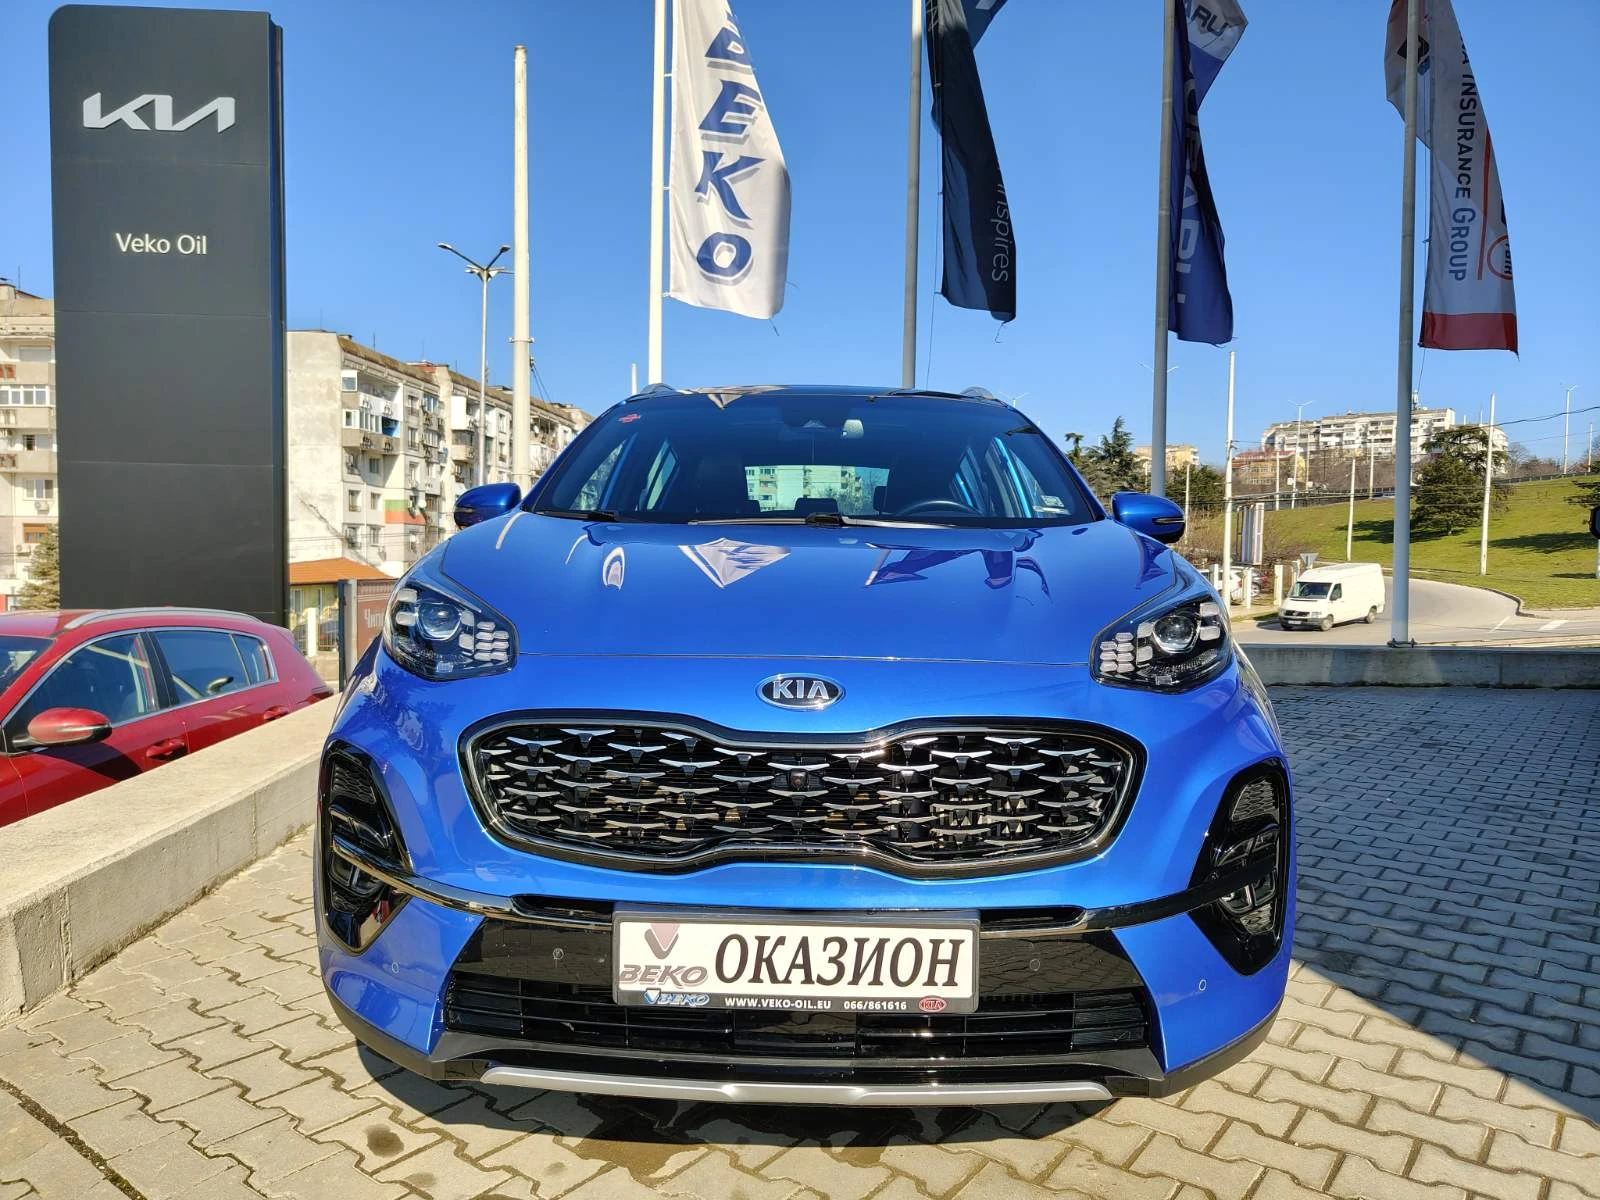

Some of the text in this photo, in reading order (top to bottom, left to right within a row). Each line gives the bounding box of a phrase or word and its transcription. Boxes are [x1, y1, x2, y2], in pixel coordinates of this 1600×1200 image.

[83, 92, 235, 133] KIA
[1454, 74, 1478, 199] INSURANCE
[115, 232, 207, 255] Veko Oil
[1448, 207, 1476, 282] GROUP
[772, 679, 830, 700] KIA
[714, 933, 966, 988] ОКАЗИОН
[724, 997, 907, 1011] WWW.VEKO-OIL.EU 066/861616
[922, 999, 944, 1011] KIA
